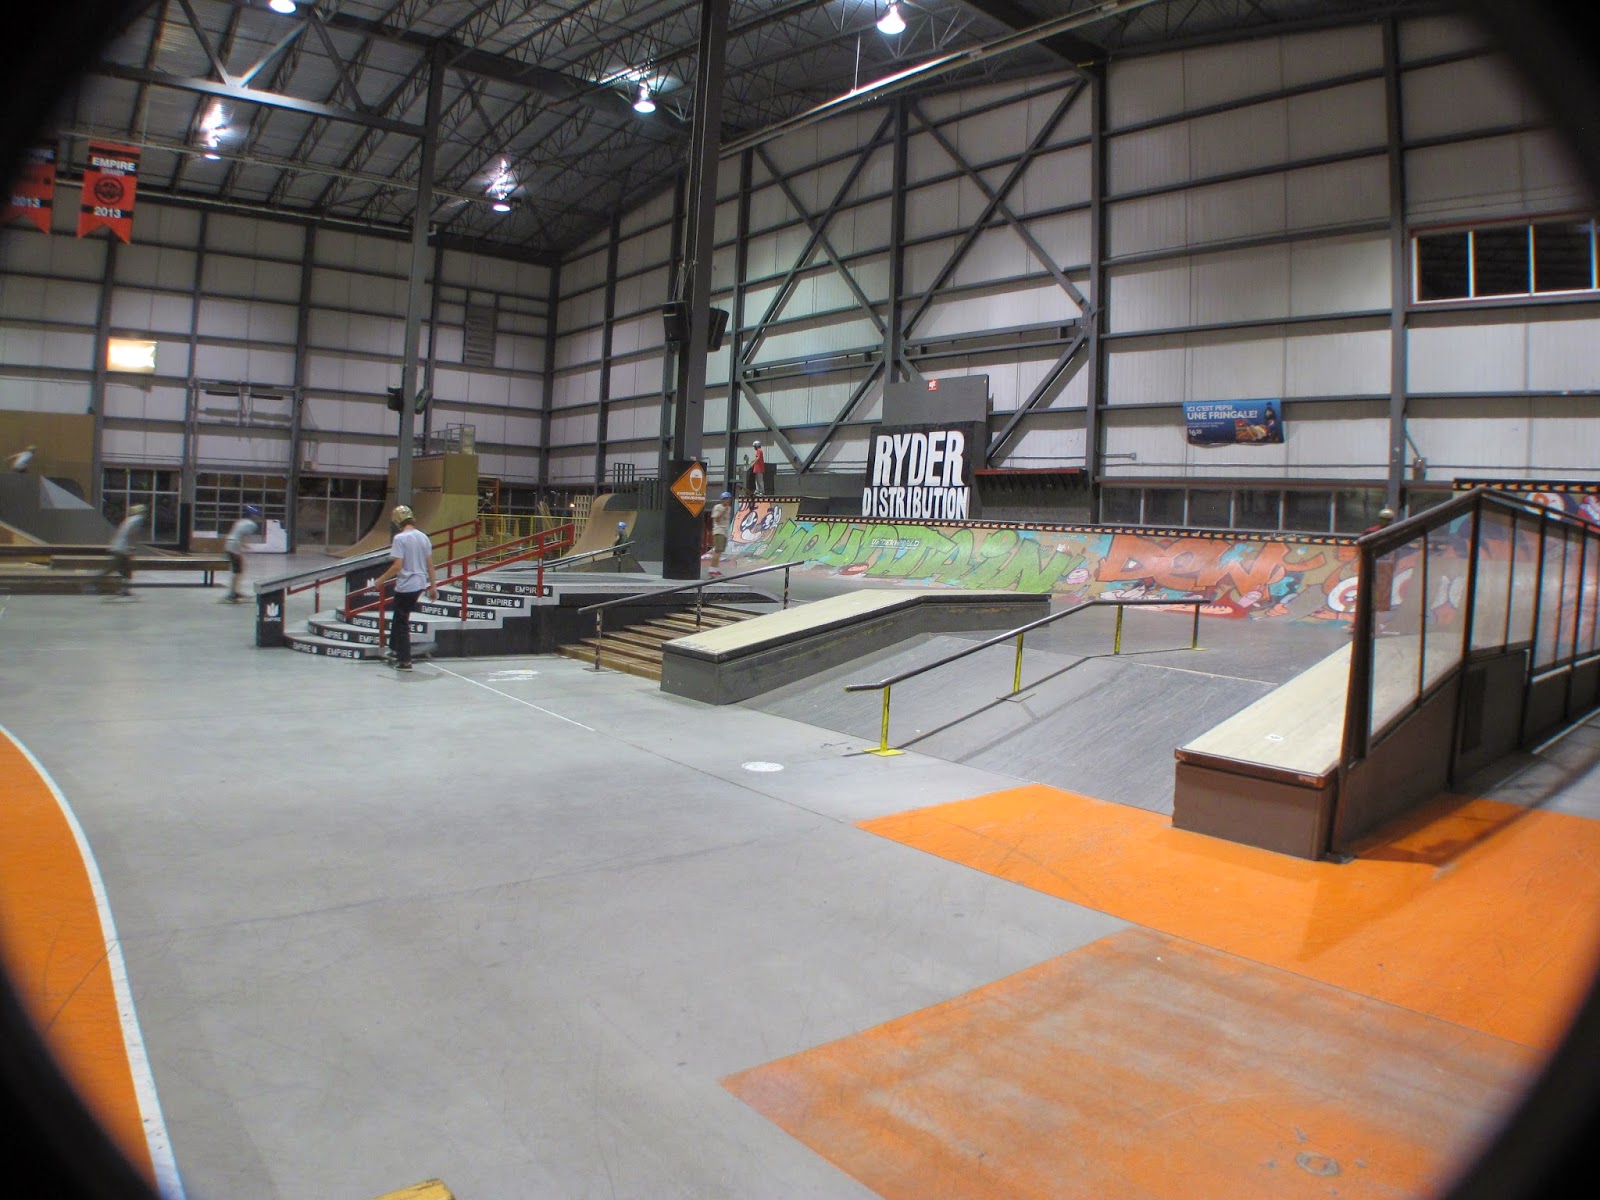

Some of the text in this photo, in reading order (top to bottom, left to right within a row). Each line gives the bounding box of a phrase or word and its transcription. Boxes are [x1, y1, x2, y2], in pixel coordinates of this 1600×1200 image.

[92, 156, 136, 171] EMPIRE
[94, 206, 122, 218] 2013
[1209, 410, 1258, 419] FRINGALE!
[872, 430, 965, 486] RYDER
[862, 486, 970, 519] DISTRIBUTION
[475, 582, 495, 590] EMPIRE
[515, 585, 537, 593] EMPIR
[447, 594, 463, 603] EMPIR
[486, 597, 513, 607] EMPIRE
[459, 609, 486, 619] EPIRE
[359, 634, 380, 644] EMPIR
[326, 647, 353, 658] EMPIRE
